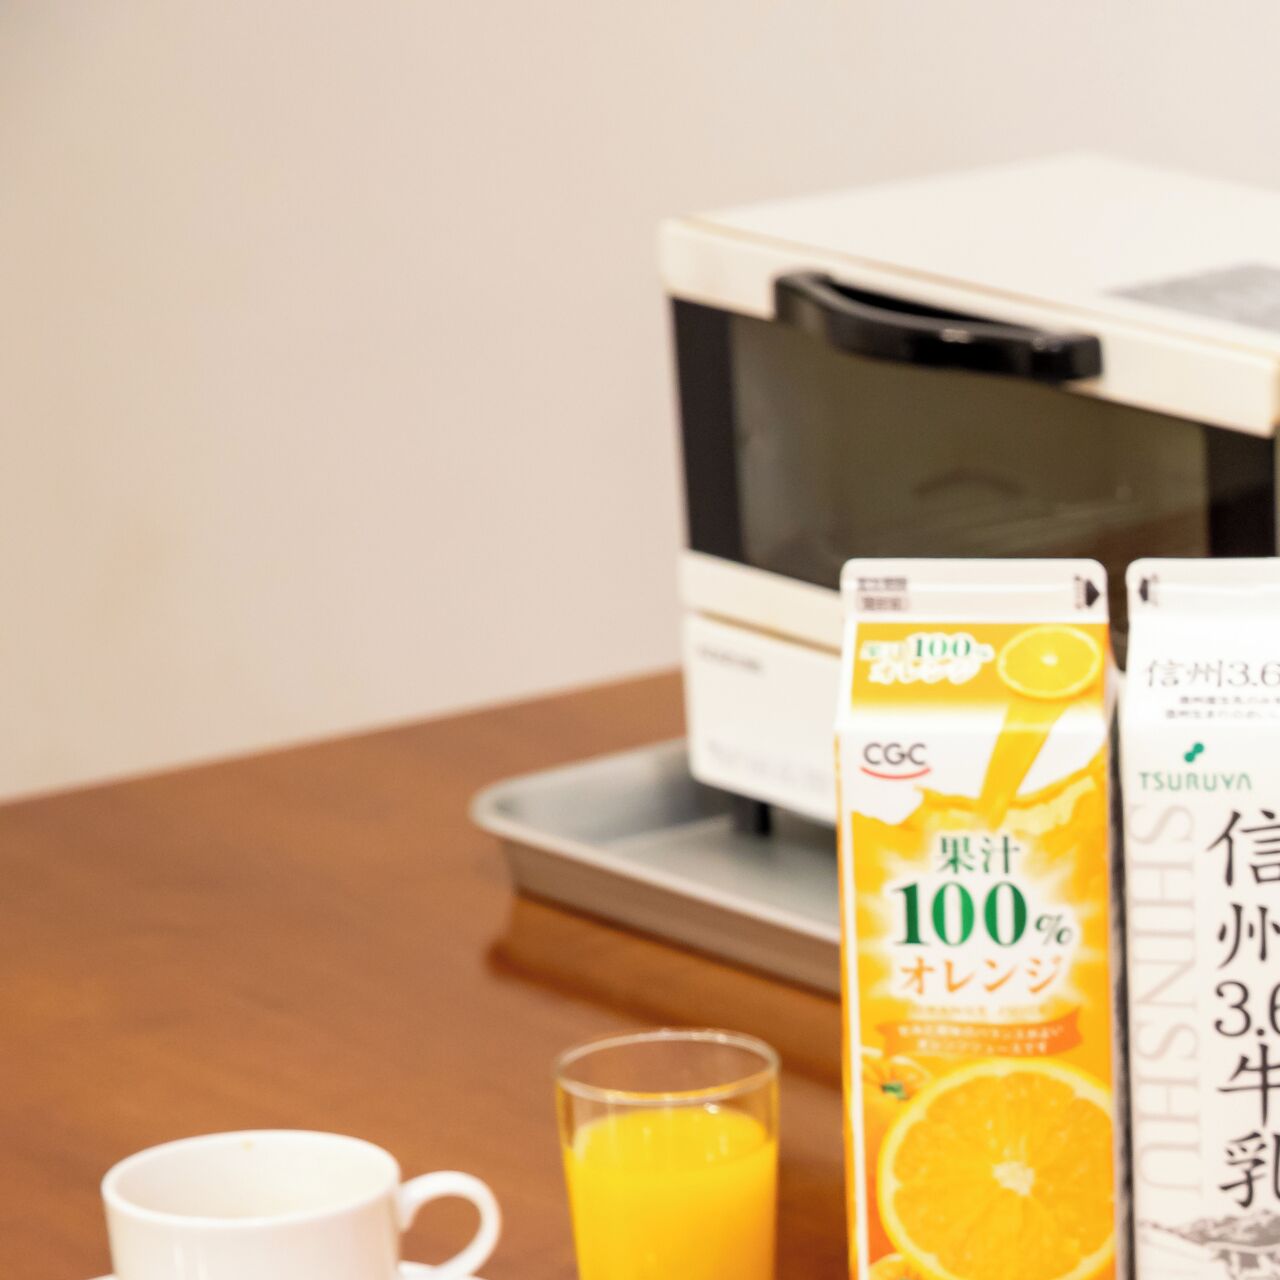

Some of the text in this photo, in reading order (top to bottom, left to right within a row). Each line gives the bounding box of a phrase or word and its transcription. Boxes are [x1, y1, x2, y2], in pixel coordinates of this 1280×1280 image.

[863, 742, 927, 766] CGC
[1140, 772, 1252, 792] TSURUYA
[937, 837, 1020, 875] 果汁
[894, 880, 1074, 947] 100%
[900, 955, 1062, 996] オレンジ
[1127, 803, 1202, 1193] SHINSHU
